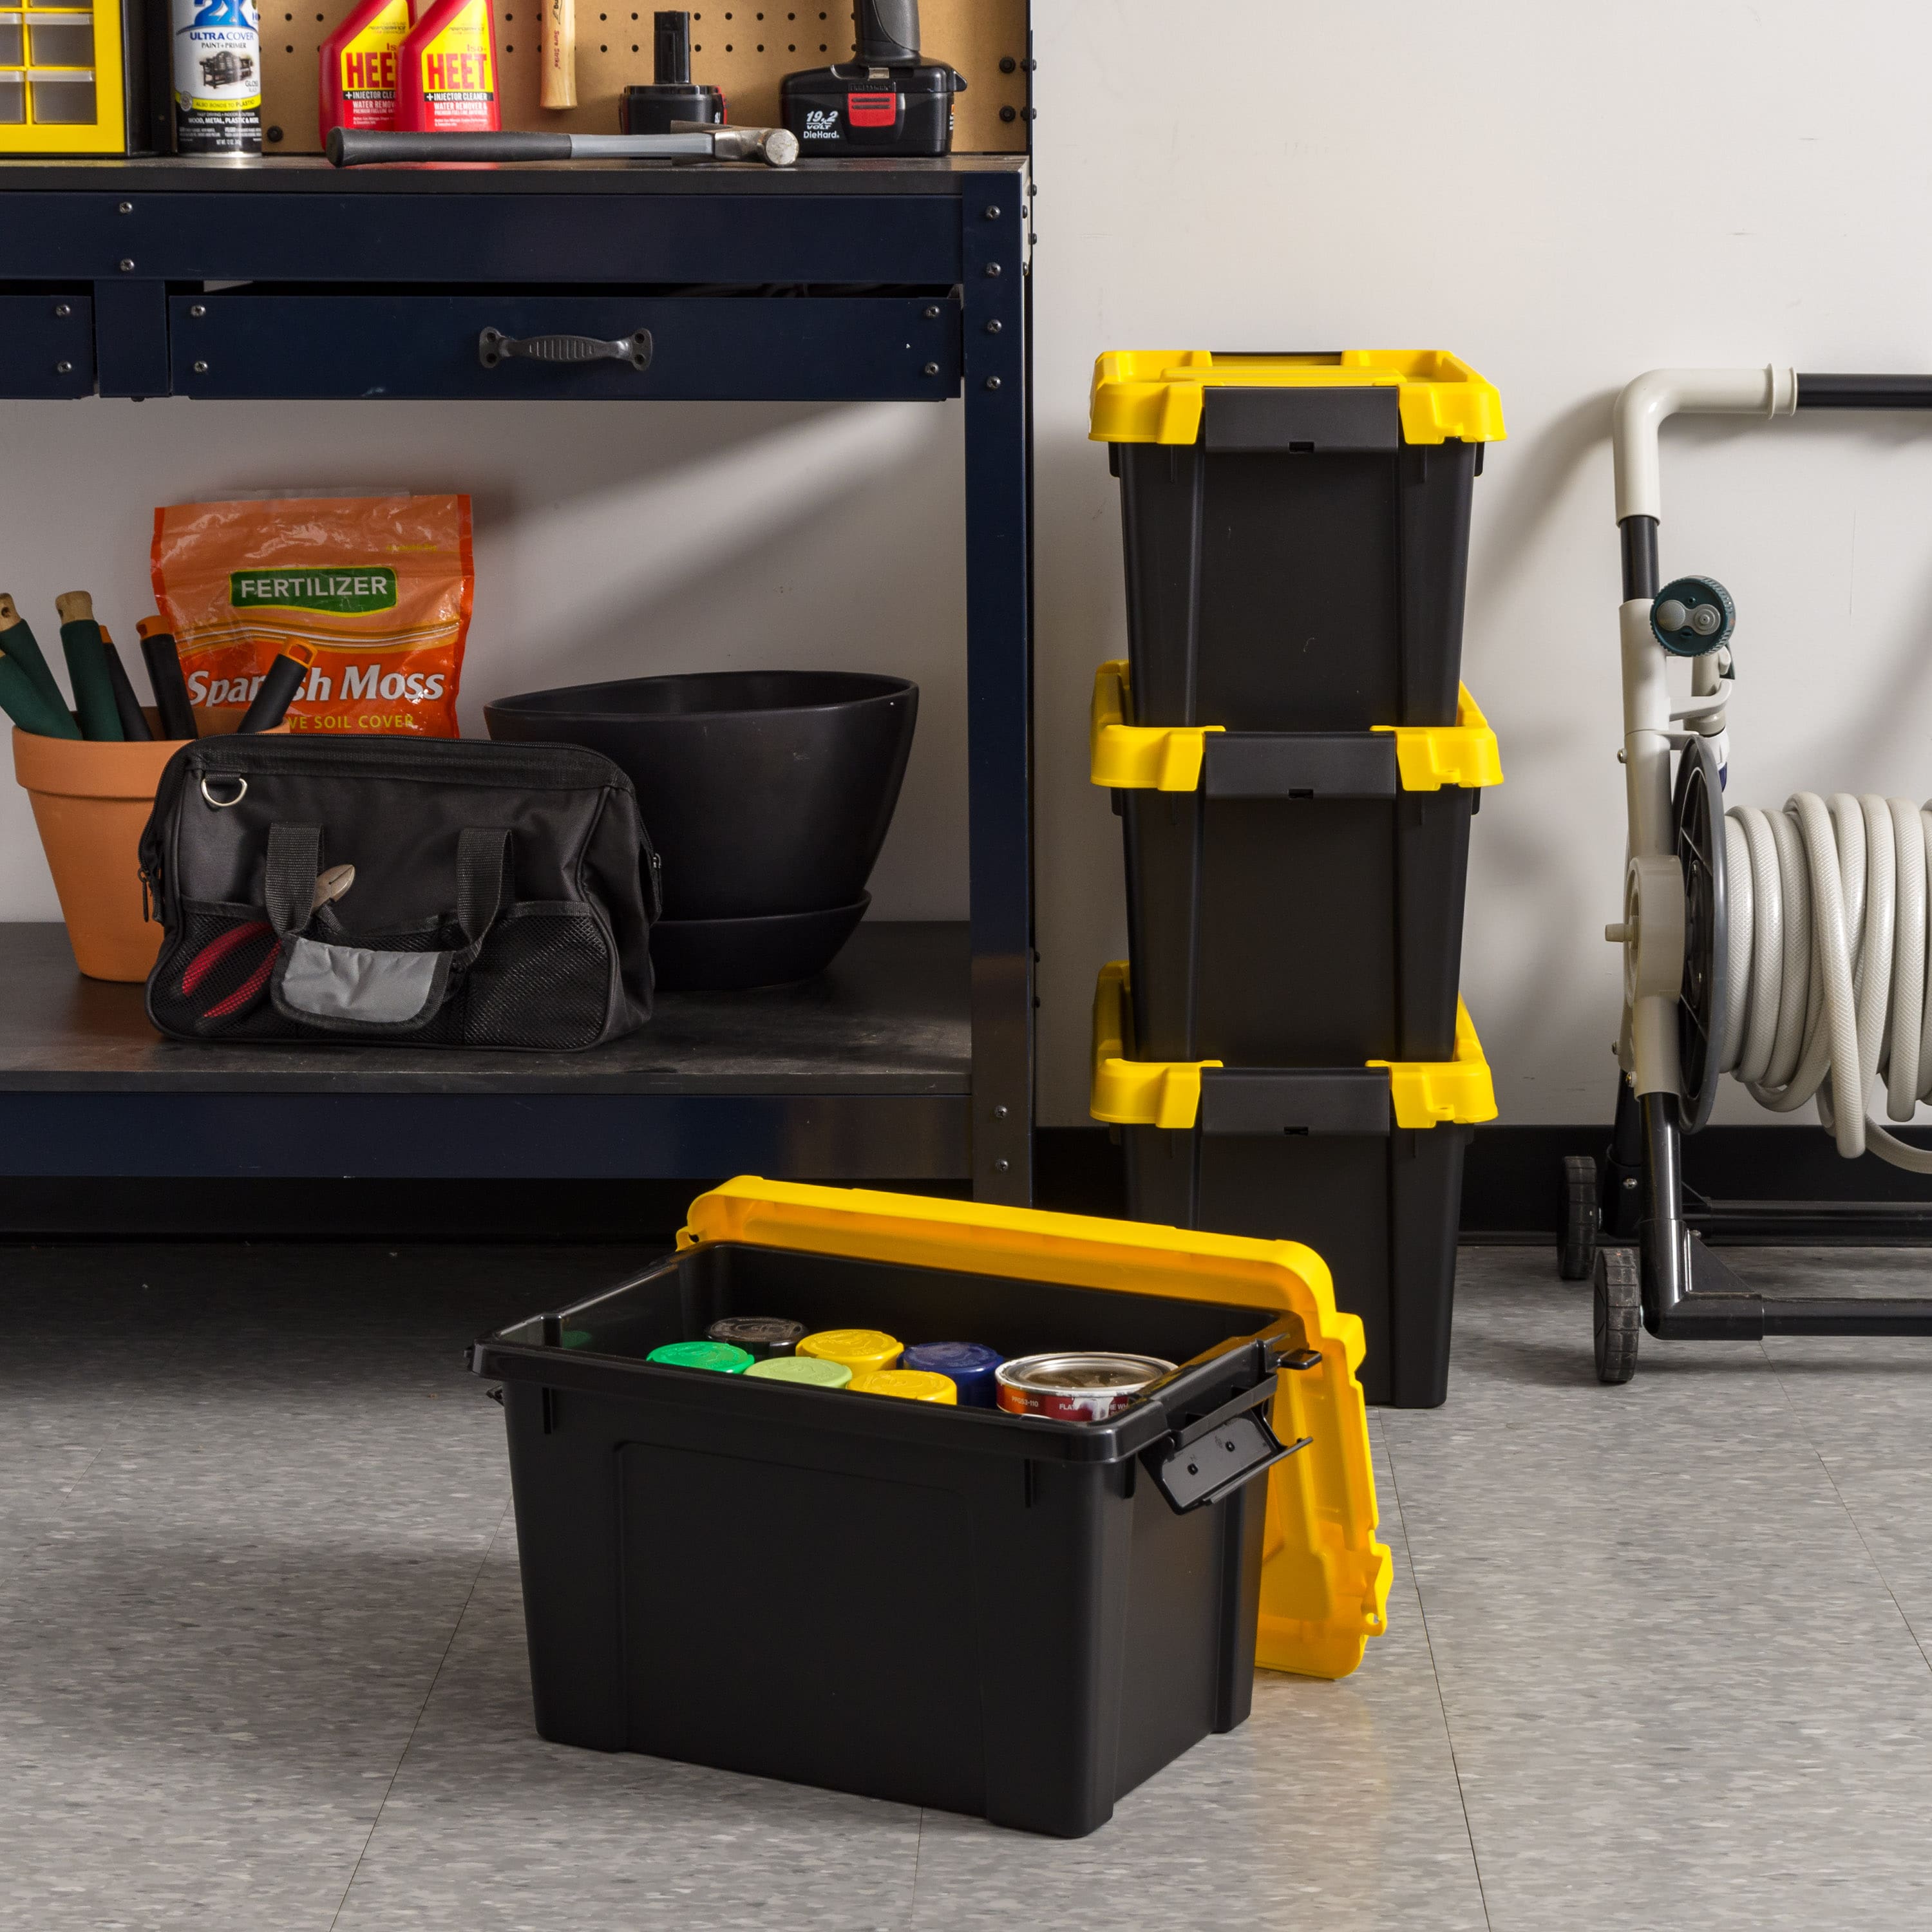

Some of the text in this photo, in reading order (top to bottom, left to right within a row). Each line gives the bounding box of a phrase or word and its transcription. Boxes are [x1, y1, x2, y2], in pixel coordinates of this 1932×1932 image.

[189, 32, 254, 40] ULTRA COVER
[386, 43, 397, 51] Is
[346, 52, 396, 88] HEE
[426, 53, 487, 90] HEET
[806, 110, 839, 122] 19.2
[241, 576, 388, 598] FERTILIZER
[339, 664, 445, 703] Moss
[288, 714, 414, 729] VE SOIL COVER
